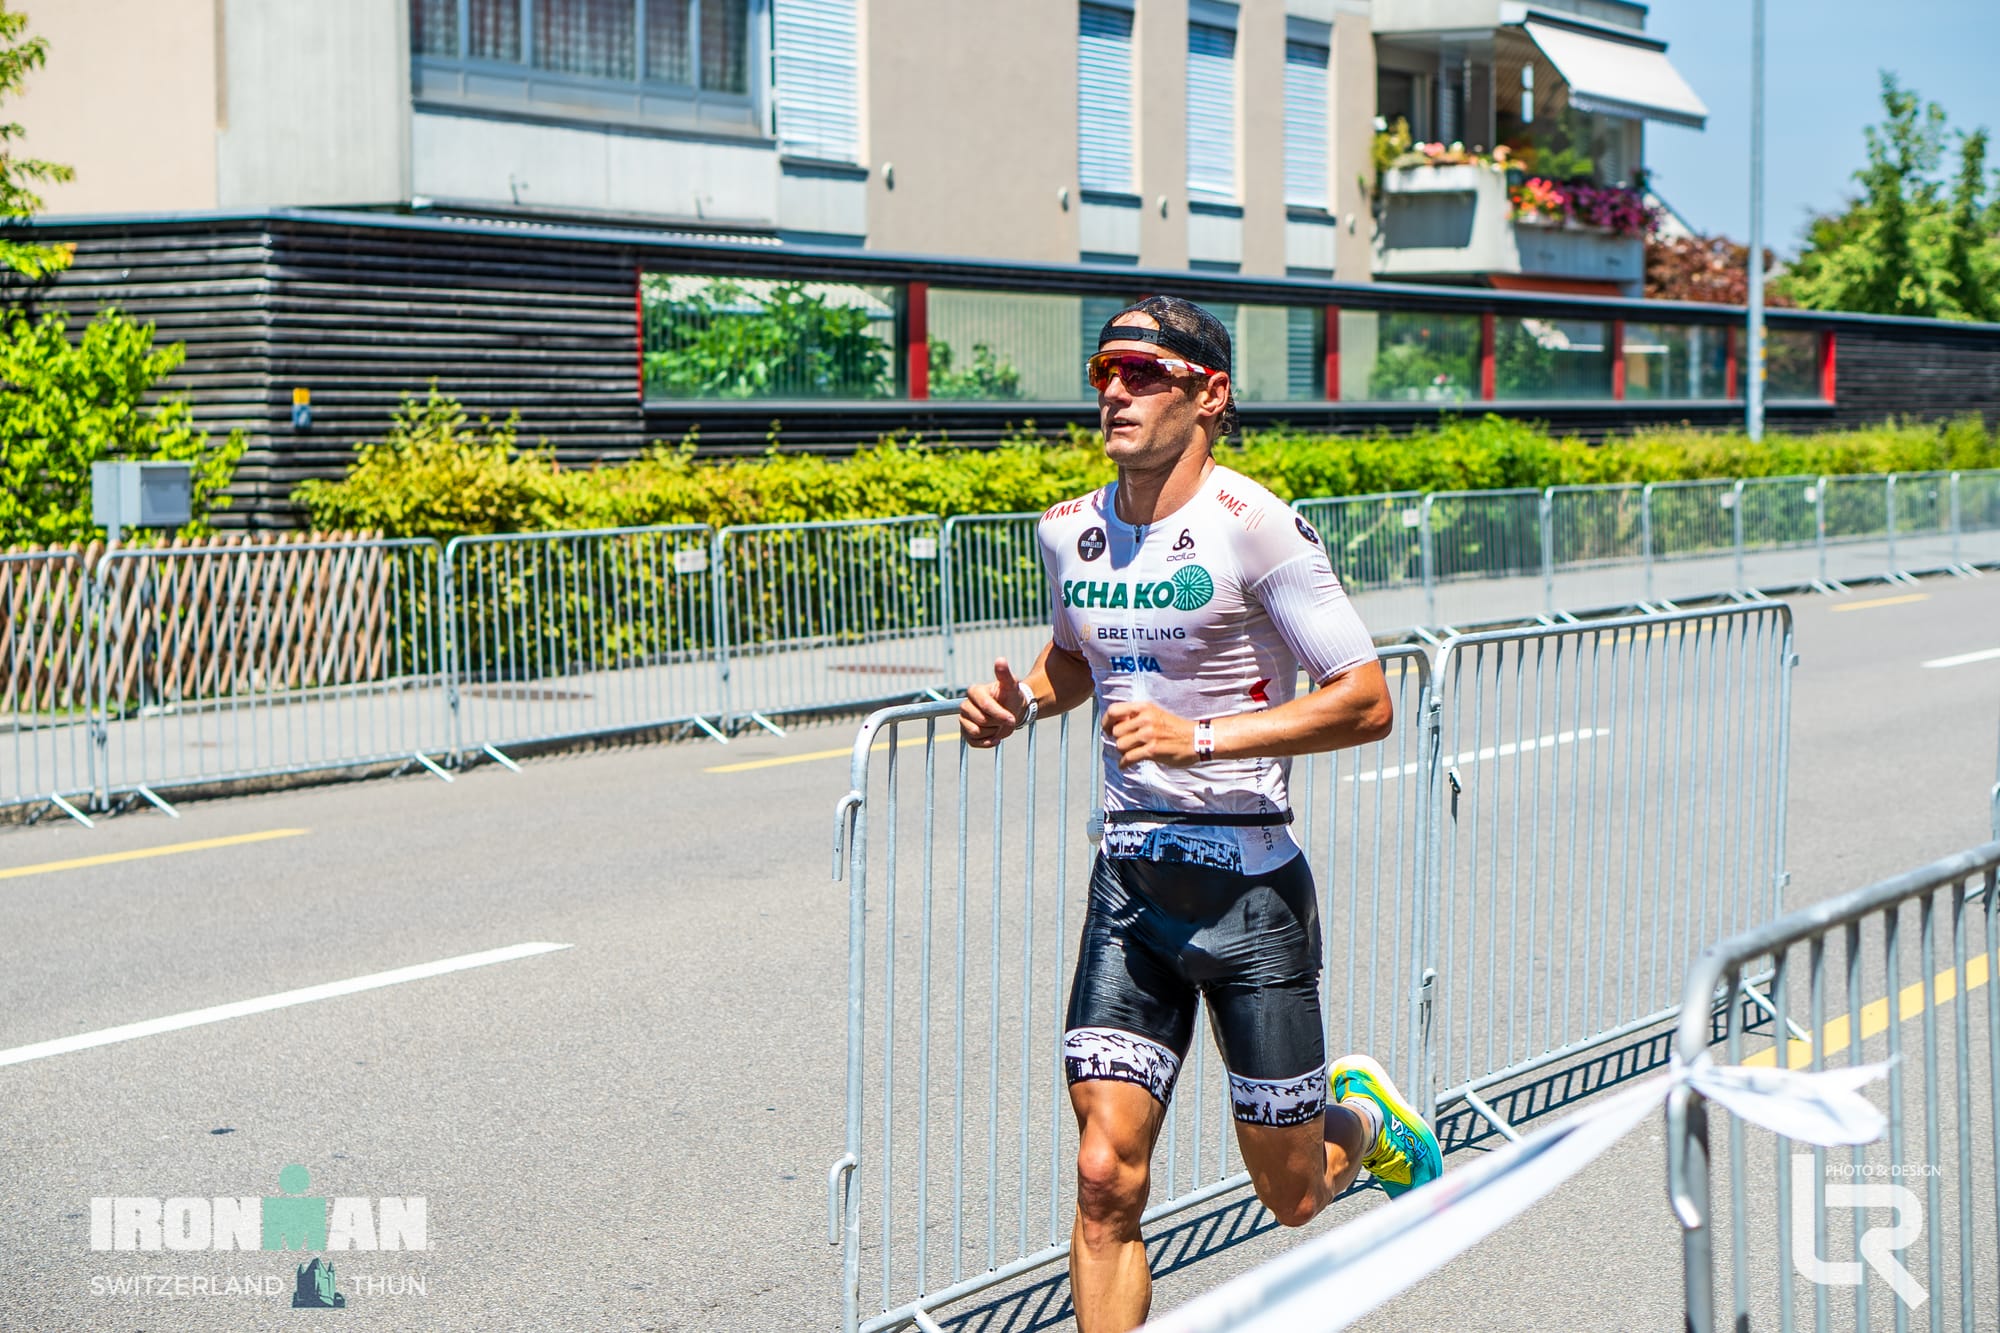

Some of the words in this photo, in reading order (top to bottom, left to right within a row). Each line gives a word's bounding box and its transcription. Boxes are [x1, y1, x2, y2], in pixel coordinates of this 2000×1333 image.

[1062, 580, 1176, 610] SCHAKO
[1097, 627, 1186, 641] BREITLING
[1111, 656, 1162, 673] HOKA
[1258, 793, 1274, 851] PROUCTS
